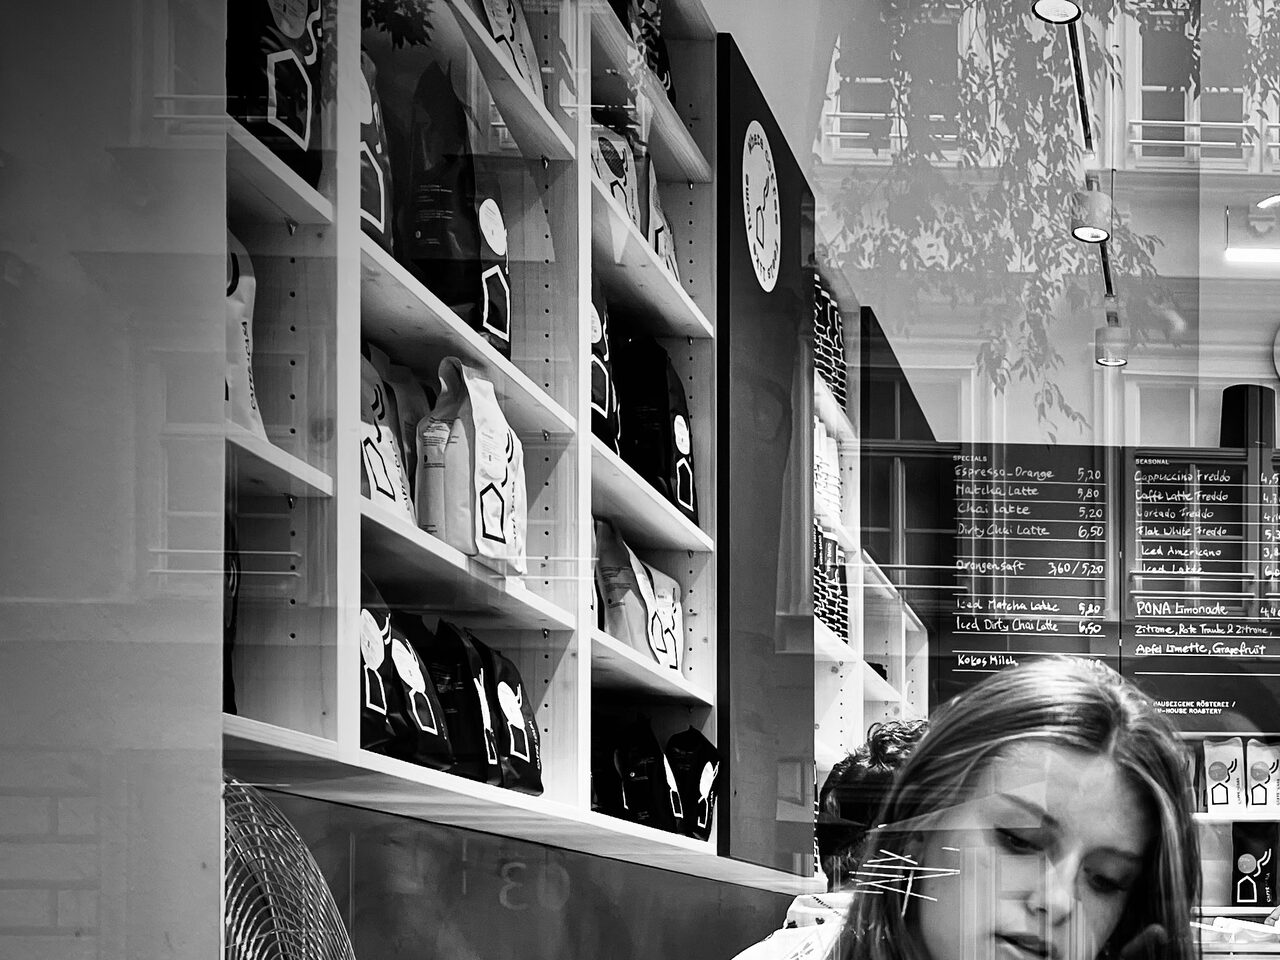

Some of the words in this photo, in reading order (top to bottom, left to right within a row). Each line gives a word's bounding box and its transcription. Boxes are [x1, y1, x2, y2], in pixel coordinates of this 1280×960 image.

[1077, 468, 1101, 482] 5,20
[1197, 470, 1230, 482] Freddo
[1008, 486, 1039, 496] Latte
[1166, 491, 1193, 500] Latte
[1194, 491, 1228, 501] Freddo
[958, 503, 988, 514] Chai
[993, 504, 1031, 515] Latte
[1079, 507, 1102, 519] 5,20
[1179, 507, 1214, 519] Freddo
[958, 523, 984, 538] Dirty
[1017, 525, 1050, 535] Latte
[1078, 525, 1103, 538] 6,50
[1136, 526, 1159, 536] Flat
[1196, 527, 1227, 536] Freddo
[1167, 546, 1221, 556] Americano
[988, 600, 1027, 611] Matcha
[1175, 602, 1228, 615] Limonade
[984, 619, 1009, 631] Dirty
[1012, 620, 1034, 631] Chai
[1036, 620, 1058, 631] Latte
[1079, 621, 1101, 634] 6,50
[1212, 642, 1266, 655] Grapefruit
[958, 654, 987, 667] Kokos
[990, 656, 1018, 667] Milch
[1197, 700, 1229, 708] RÖSTEREI
